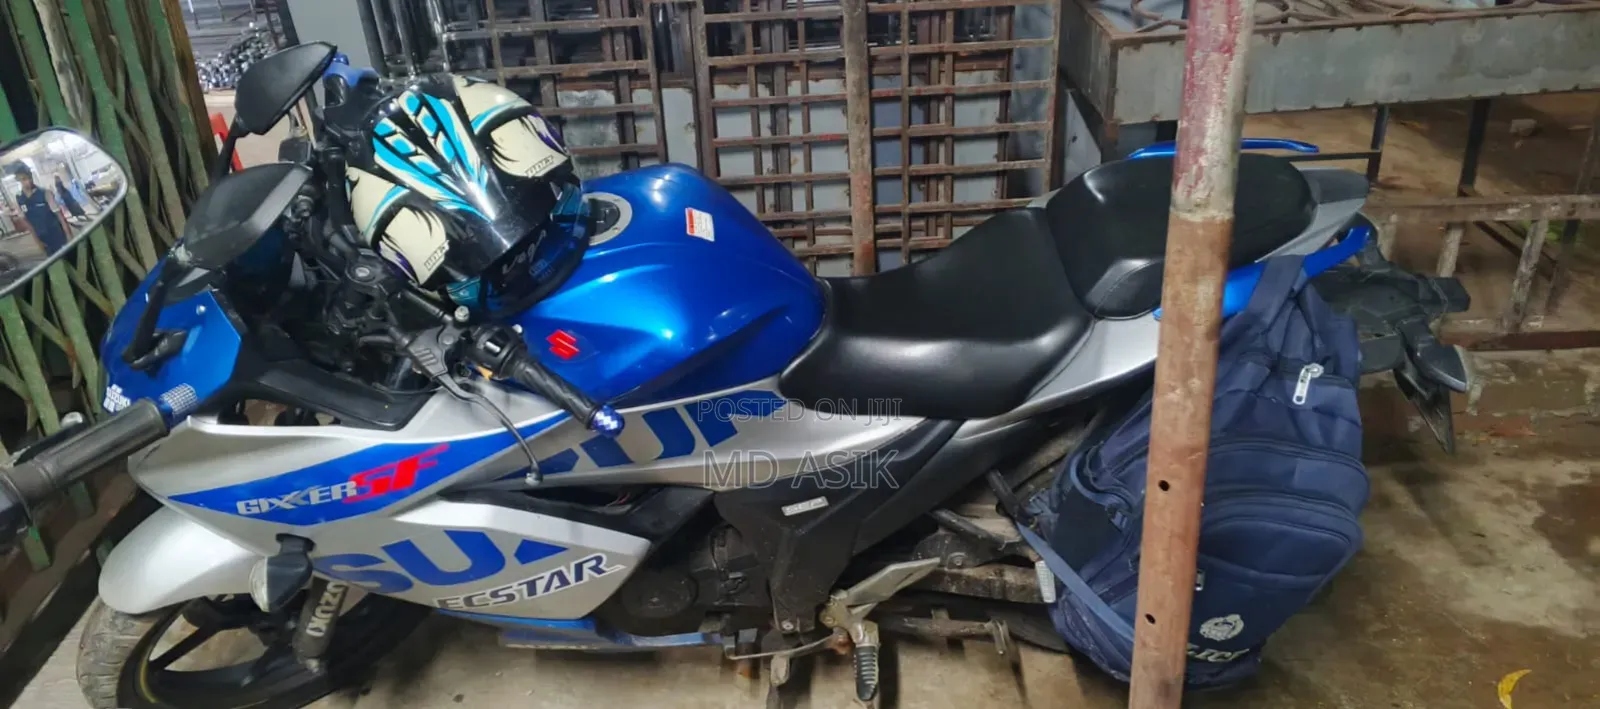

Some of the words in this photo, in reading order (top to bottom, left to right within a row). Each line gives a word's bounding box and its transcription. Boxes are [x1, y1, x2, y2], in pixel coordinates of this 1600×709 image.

[236, 480, 358, 515] GIXXER
[342, 443, 450, 504] SF
[305, 580, 348, 637] UZUKI
[434, 552, 627, 610] ECSTAR
